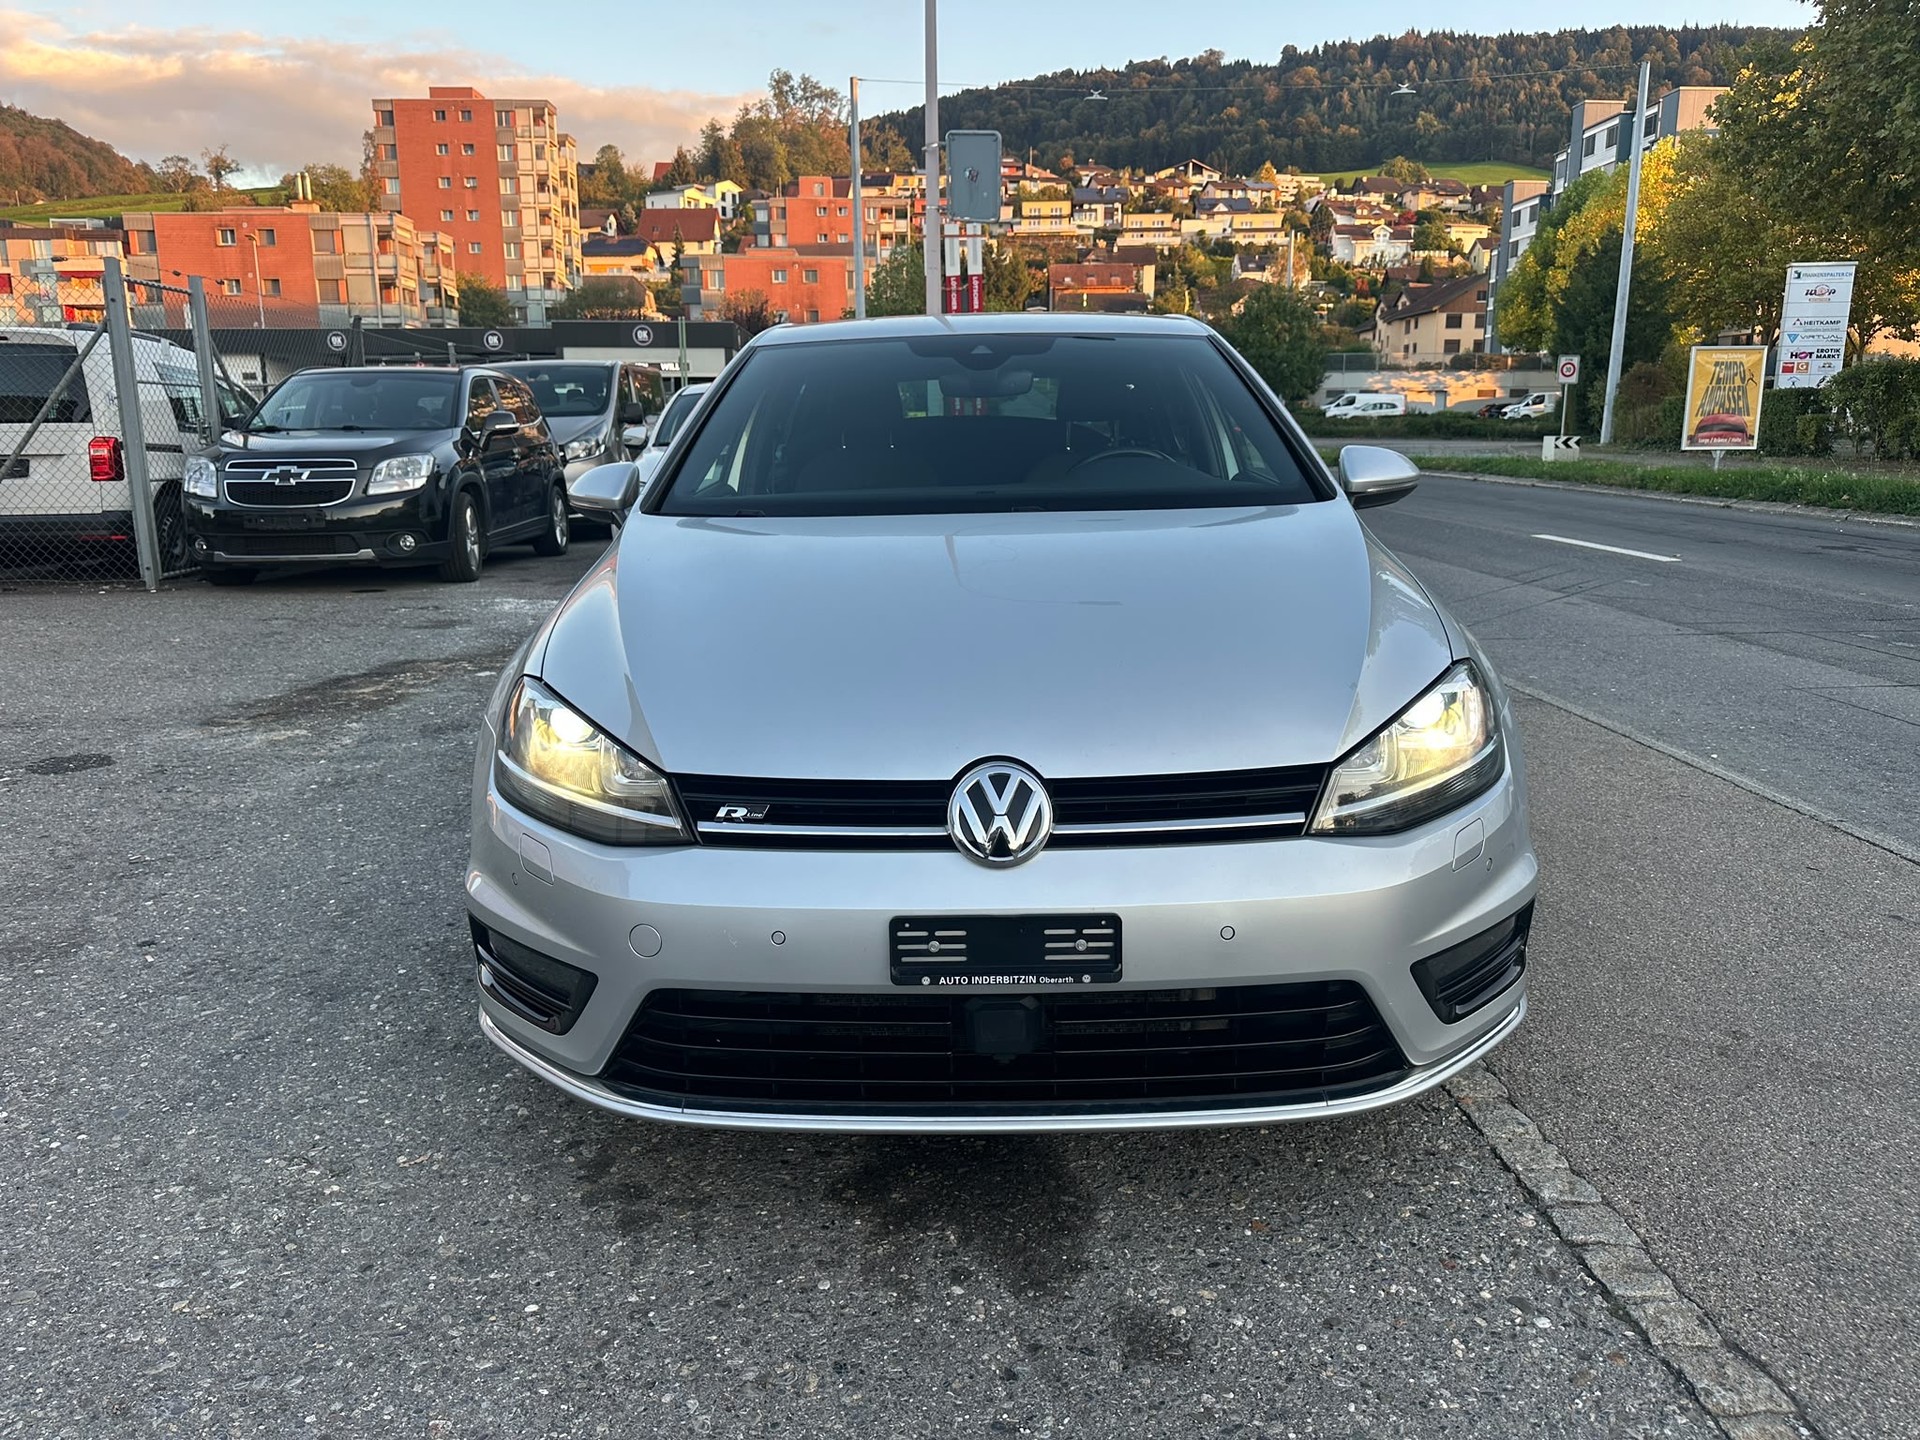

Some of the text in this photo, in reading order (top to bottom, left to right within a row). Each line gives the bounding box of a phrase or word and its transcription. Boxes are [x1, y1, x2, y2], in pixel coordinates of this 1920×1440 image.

[1790, 351, 1814, 359] HOT
[1709, 361, 1746, 385] TEMPO
[1695, 386, 1750, 417] ANPASSEN
[939, 975, 1074, 985] AUTO INDERBITZIN Oberarth
